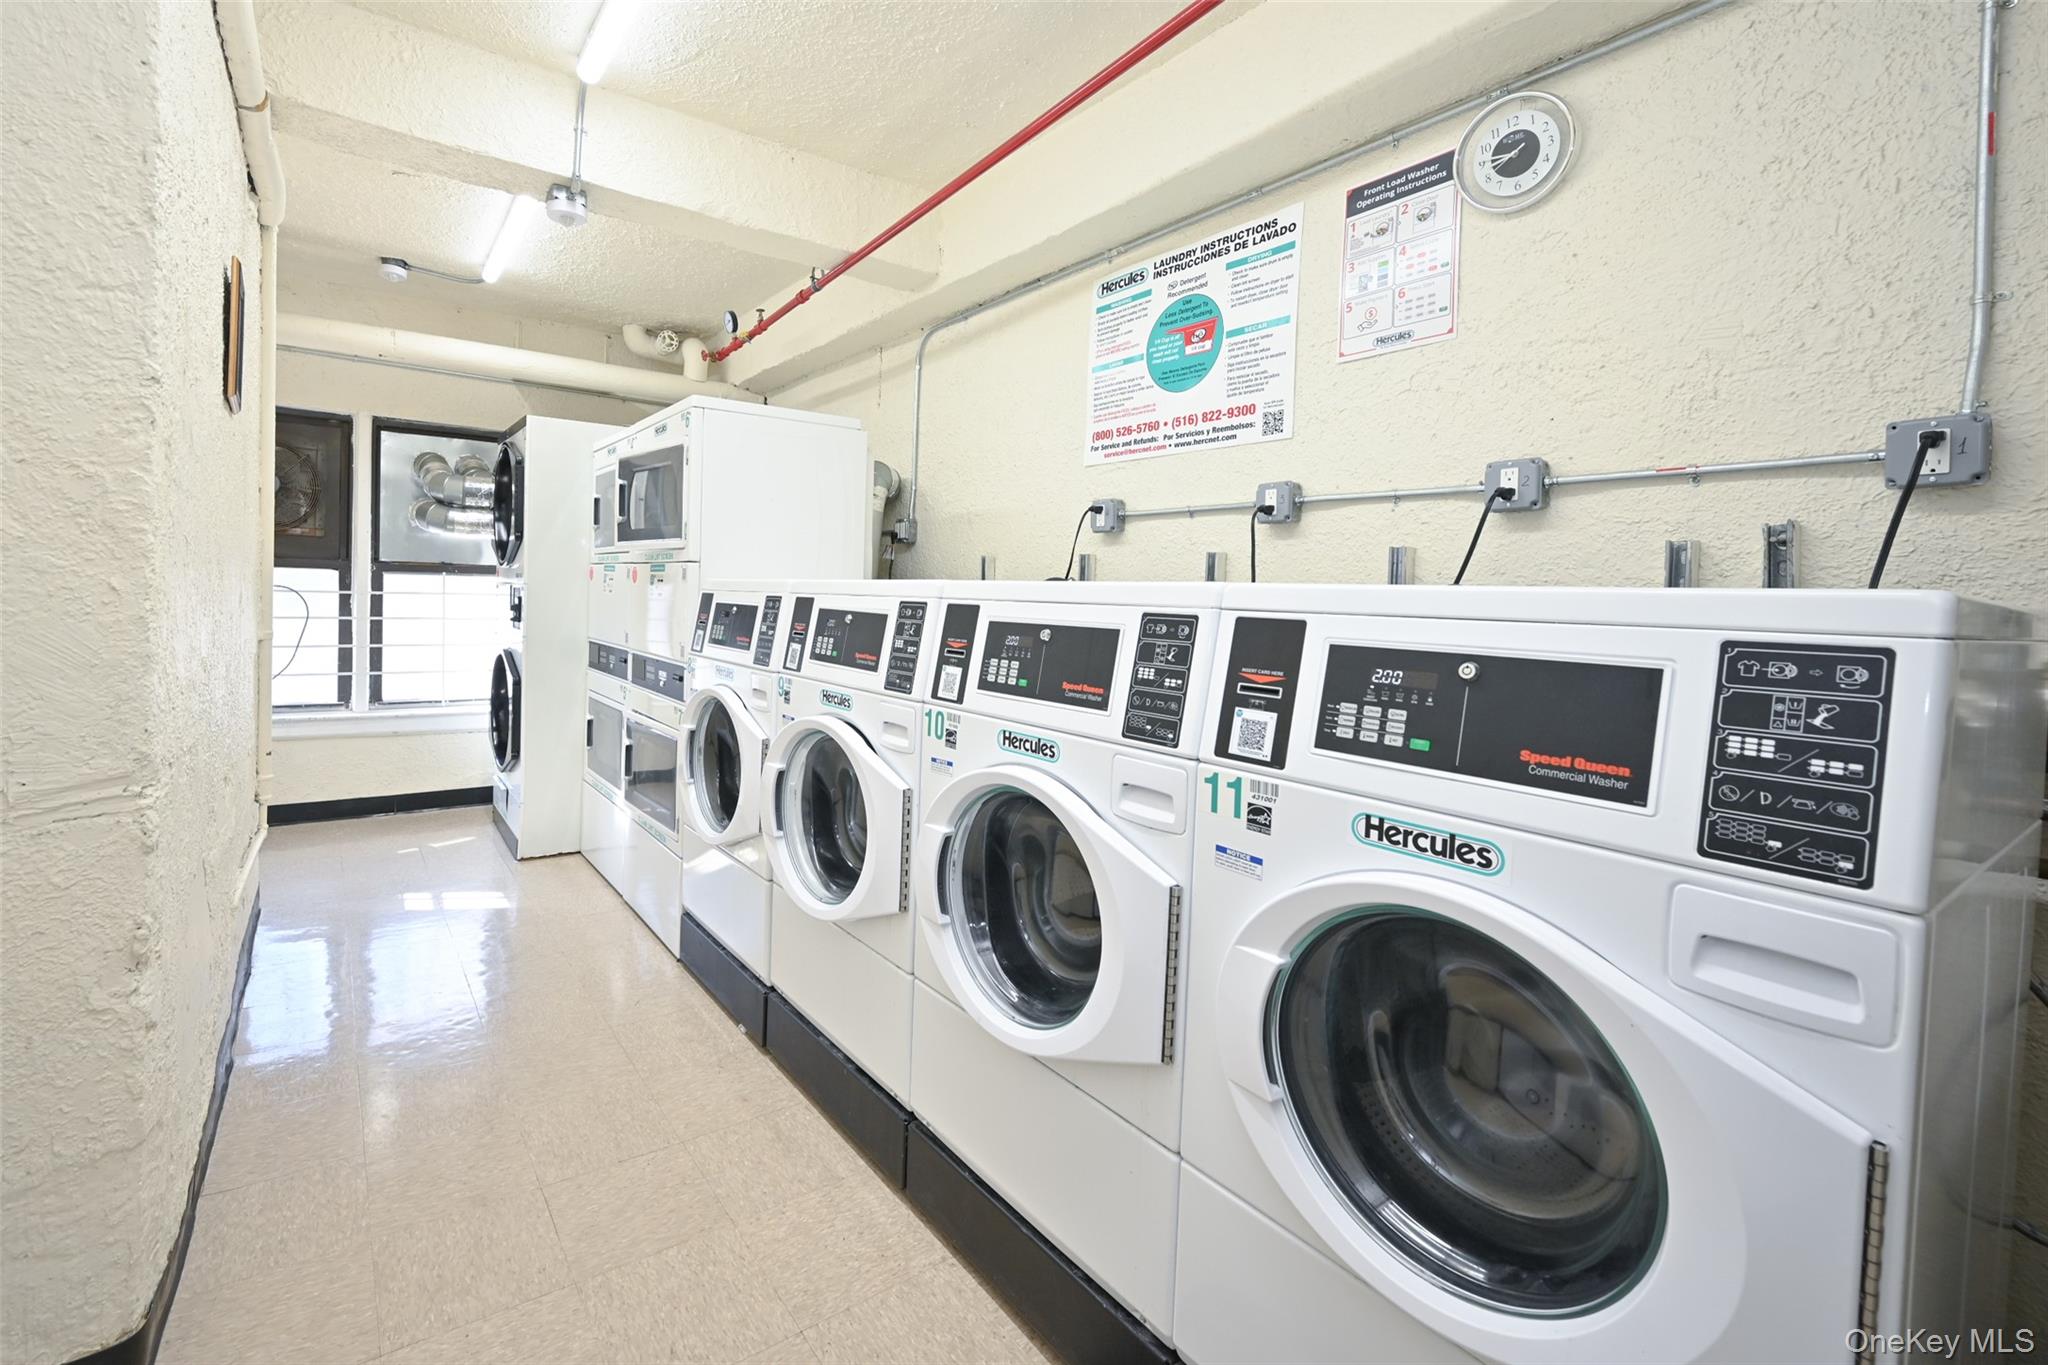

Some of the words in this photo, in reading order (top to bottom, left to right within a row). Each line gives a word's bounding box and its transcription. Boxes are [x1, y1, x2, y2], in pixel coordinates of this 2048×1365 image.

[1507, 115, 1520, 129] 12
[1531, 114, 1535, 125] 1
[1491, 127, 1500, 139] 11
[1543, 121, 1550, 133] 2
[1548, 135, 1555, 147] 3
[1480, 143, 1492, 155] 10
[1543, 153, 1550, 163] 4
[1478, 161, 1486, 170] 9
[1363, 183, 1385, 197] Front
[1386, 175, 1406, 188] Load
[1407, 163, 1439, 180] Washer
[1485, 173, 1492, 183] 8
[1532, 168, 1539, 180] 5
[1356, 190, 1395, 208] Operating
[1396, 170, 1447, 192] Instructions
[1496, 180, 1503, 191] 7
[1514, 180, 1522, 192] 6
[1400, 203, 1409, 215] 2
[1350, 222, 1356, 232] 1
[1153, 248, 1197, 270] LAUNDRY
[1200, 218, 1278, 253] INSTRUCTIONS
[1153, 246, 1230, 279] INSTRUCCIONES
[1233, 240, 1249, 252] DE
[1252, 222, 1297, 245] LAVADO
[1399, 246, 1406, 256] 4
[1347, 262, 1355, 273] 3
[1101, 271, 1145, 295] Hercules
[1180, 272, 1207, 286] Detergent
[1167, 281, 1208, 298] Recommended
[1398, 288, 1406, 299] 6
[1345, 303, 1353, 313] 5
[1375, 331, 1412, 345] Hercules
[1092, 429, 1114, 443] (800)
[1115, 420, 1160, 437] 526-5760
[1171, 413, 1199, 430] (516)
[1201, 403, 1256, 423] 822-9300
[1100, 442, 1120, 451] Service
[1121, 440, 1133, 448] and
[1133, 436, 1159, 446] Refunds:
[1175, 429, 1205, 440] Servicios
[1211, 421, 1256, 434] Reembolsos:
[1173, 434, 1237, 448] www.hercnet.com
[1521, 475, 1530, 487] 2
[1371, 668, 1403, 685] 2.00
[778, 676, 784, 697] 9
[1062, 682, 1082, 691] Speed
[1083, 685, 1104, 694] Queen
[822, 689, 851, 709] Hercules
[925, 709, 945, 740] 10
[1003, 730, 1056, 758] Hercules
[1520, 750, 1572, 767] Speed
[1574, 757, 1631, 777] Queen
[1528, 765, 1586, 783] Commercial
[1588, 774, 1629, 790] Washer
[1204, 772, 1243, 819] 11
[1252, 794, 1277, 804] 431001
[1364, 814, 1493, 869] Hercules
